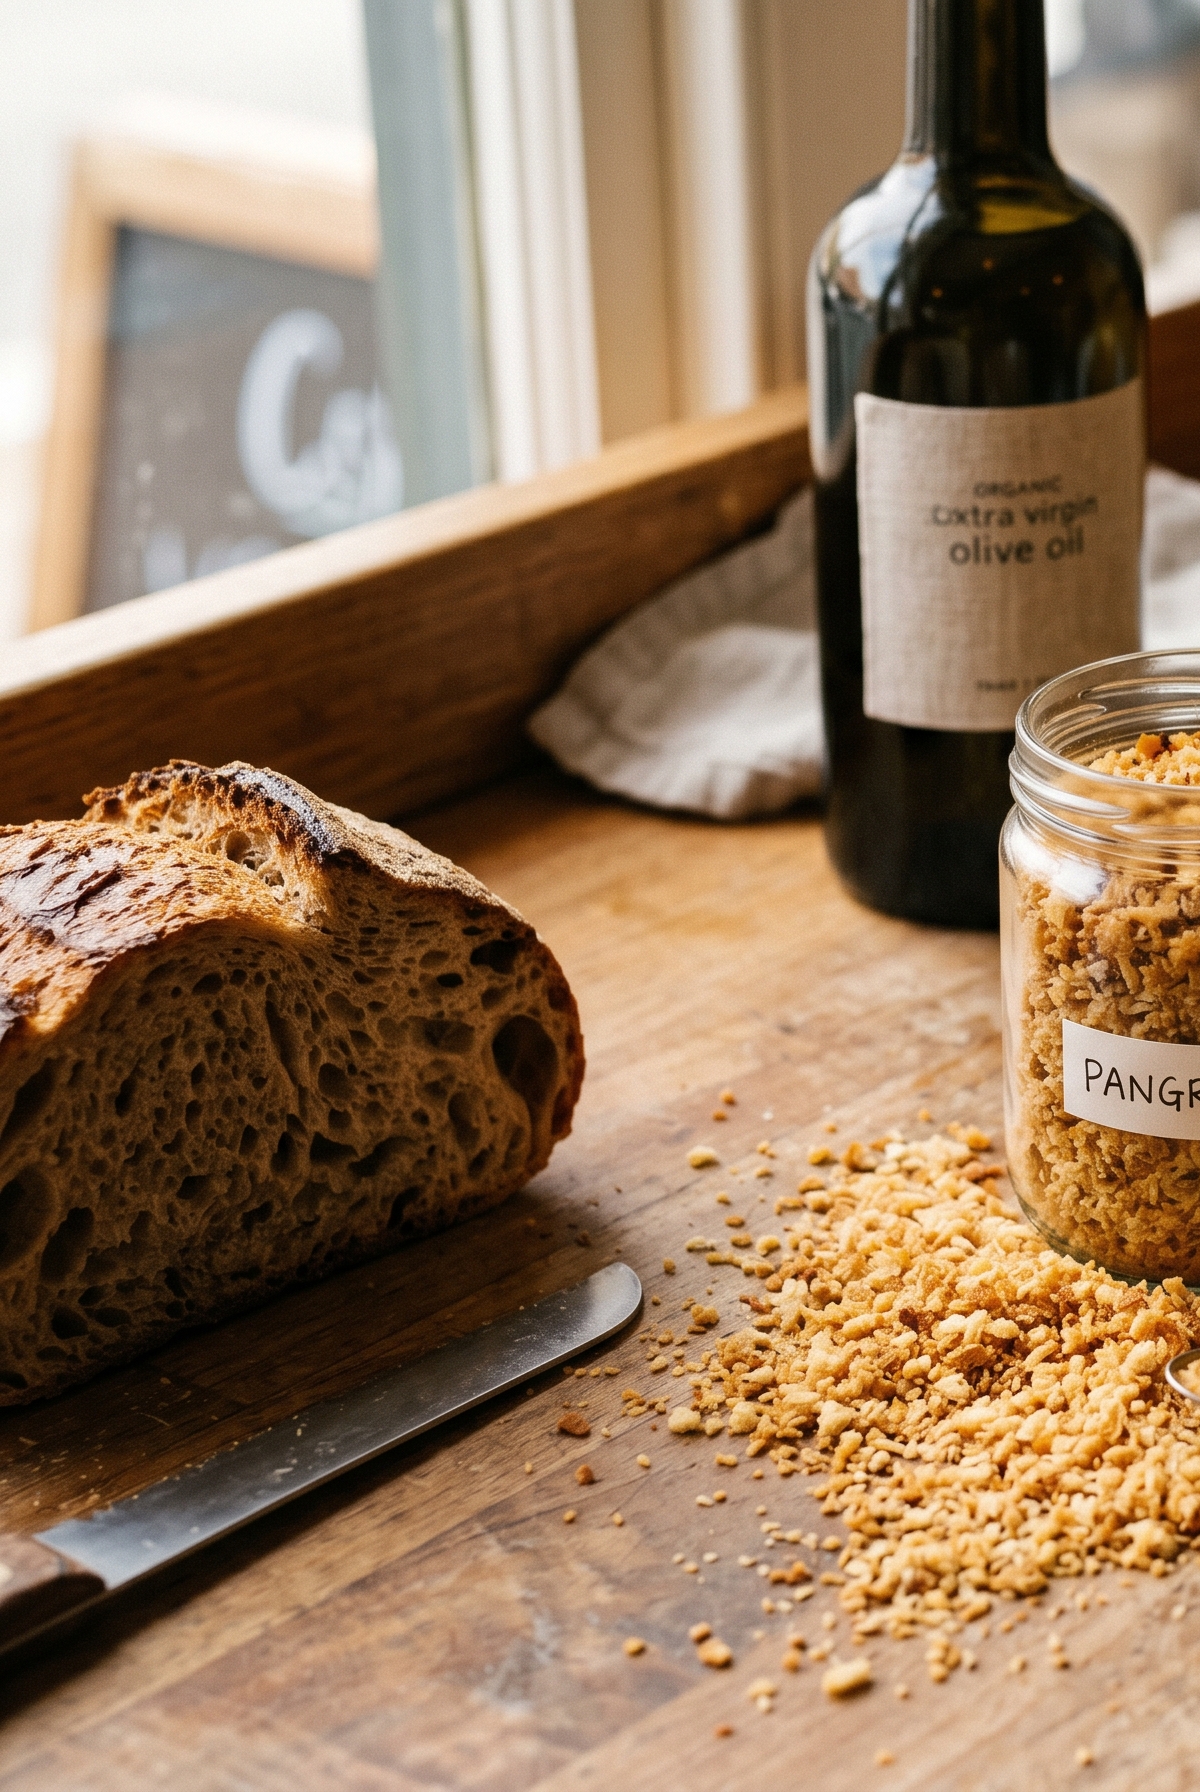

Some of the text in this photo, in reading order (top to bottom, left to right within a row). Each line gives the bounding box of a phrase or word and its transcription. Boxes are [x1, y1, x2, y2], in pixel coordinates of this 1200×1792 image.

[973, 475, 1062, 498] ORGANIC
[949, 524, 1085, 566] olive oil
